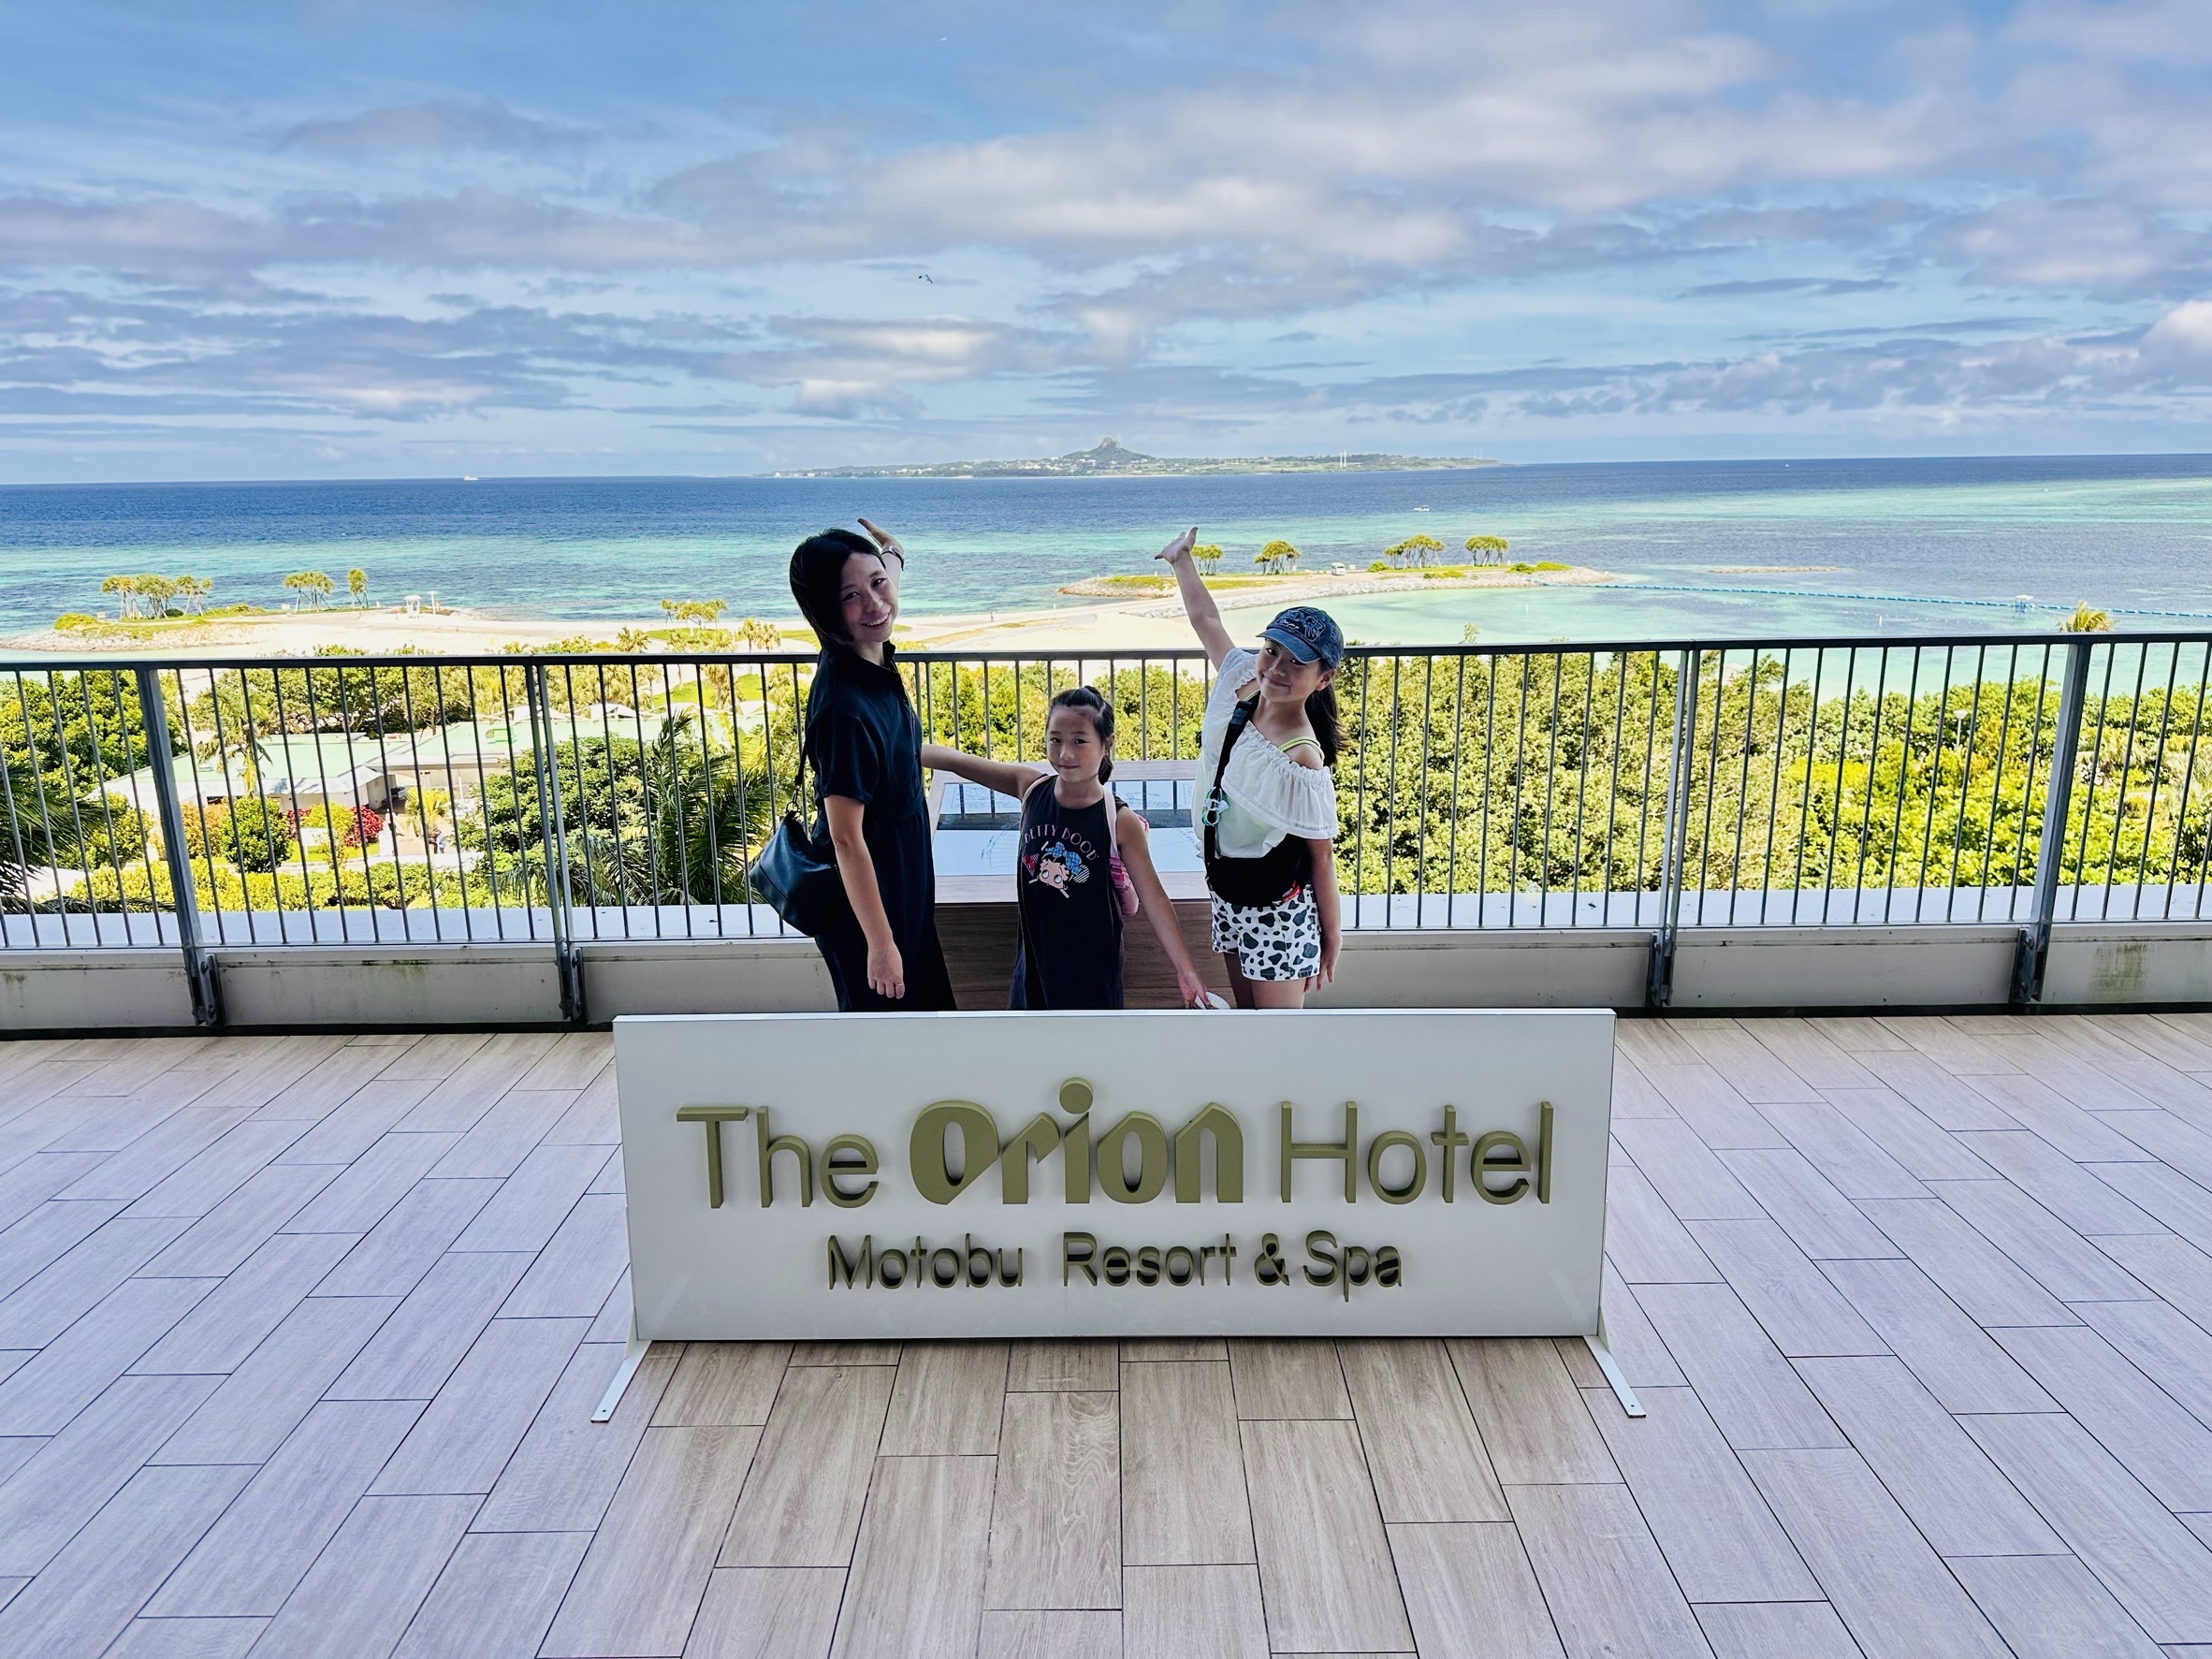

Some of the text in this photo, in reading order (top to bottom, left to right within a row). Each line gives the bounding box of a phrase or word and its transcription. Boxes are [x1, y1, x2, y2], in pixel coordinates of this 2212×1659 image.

[677, 1106, 879, 1209] The
[1281, 1101, 1553, 1204] Hotel
[827, 1230, 1402, 1302] Motobu Resort & Spa
